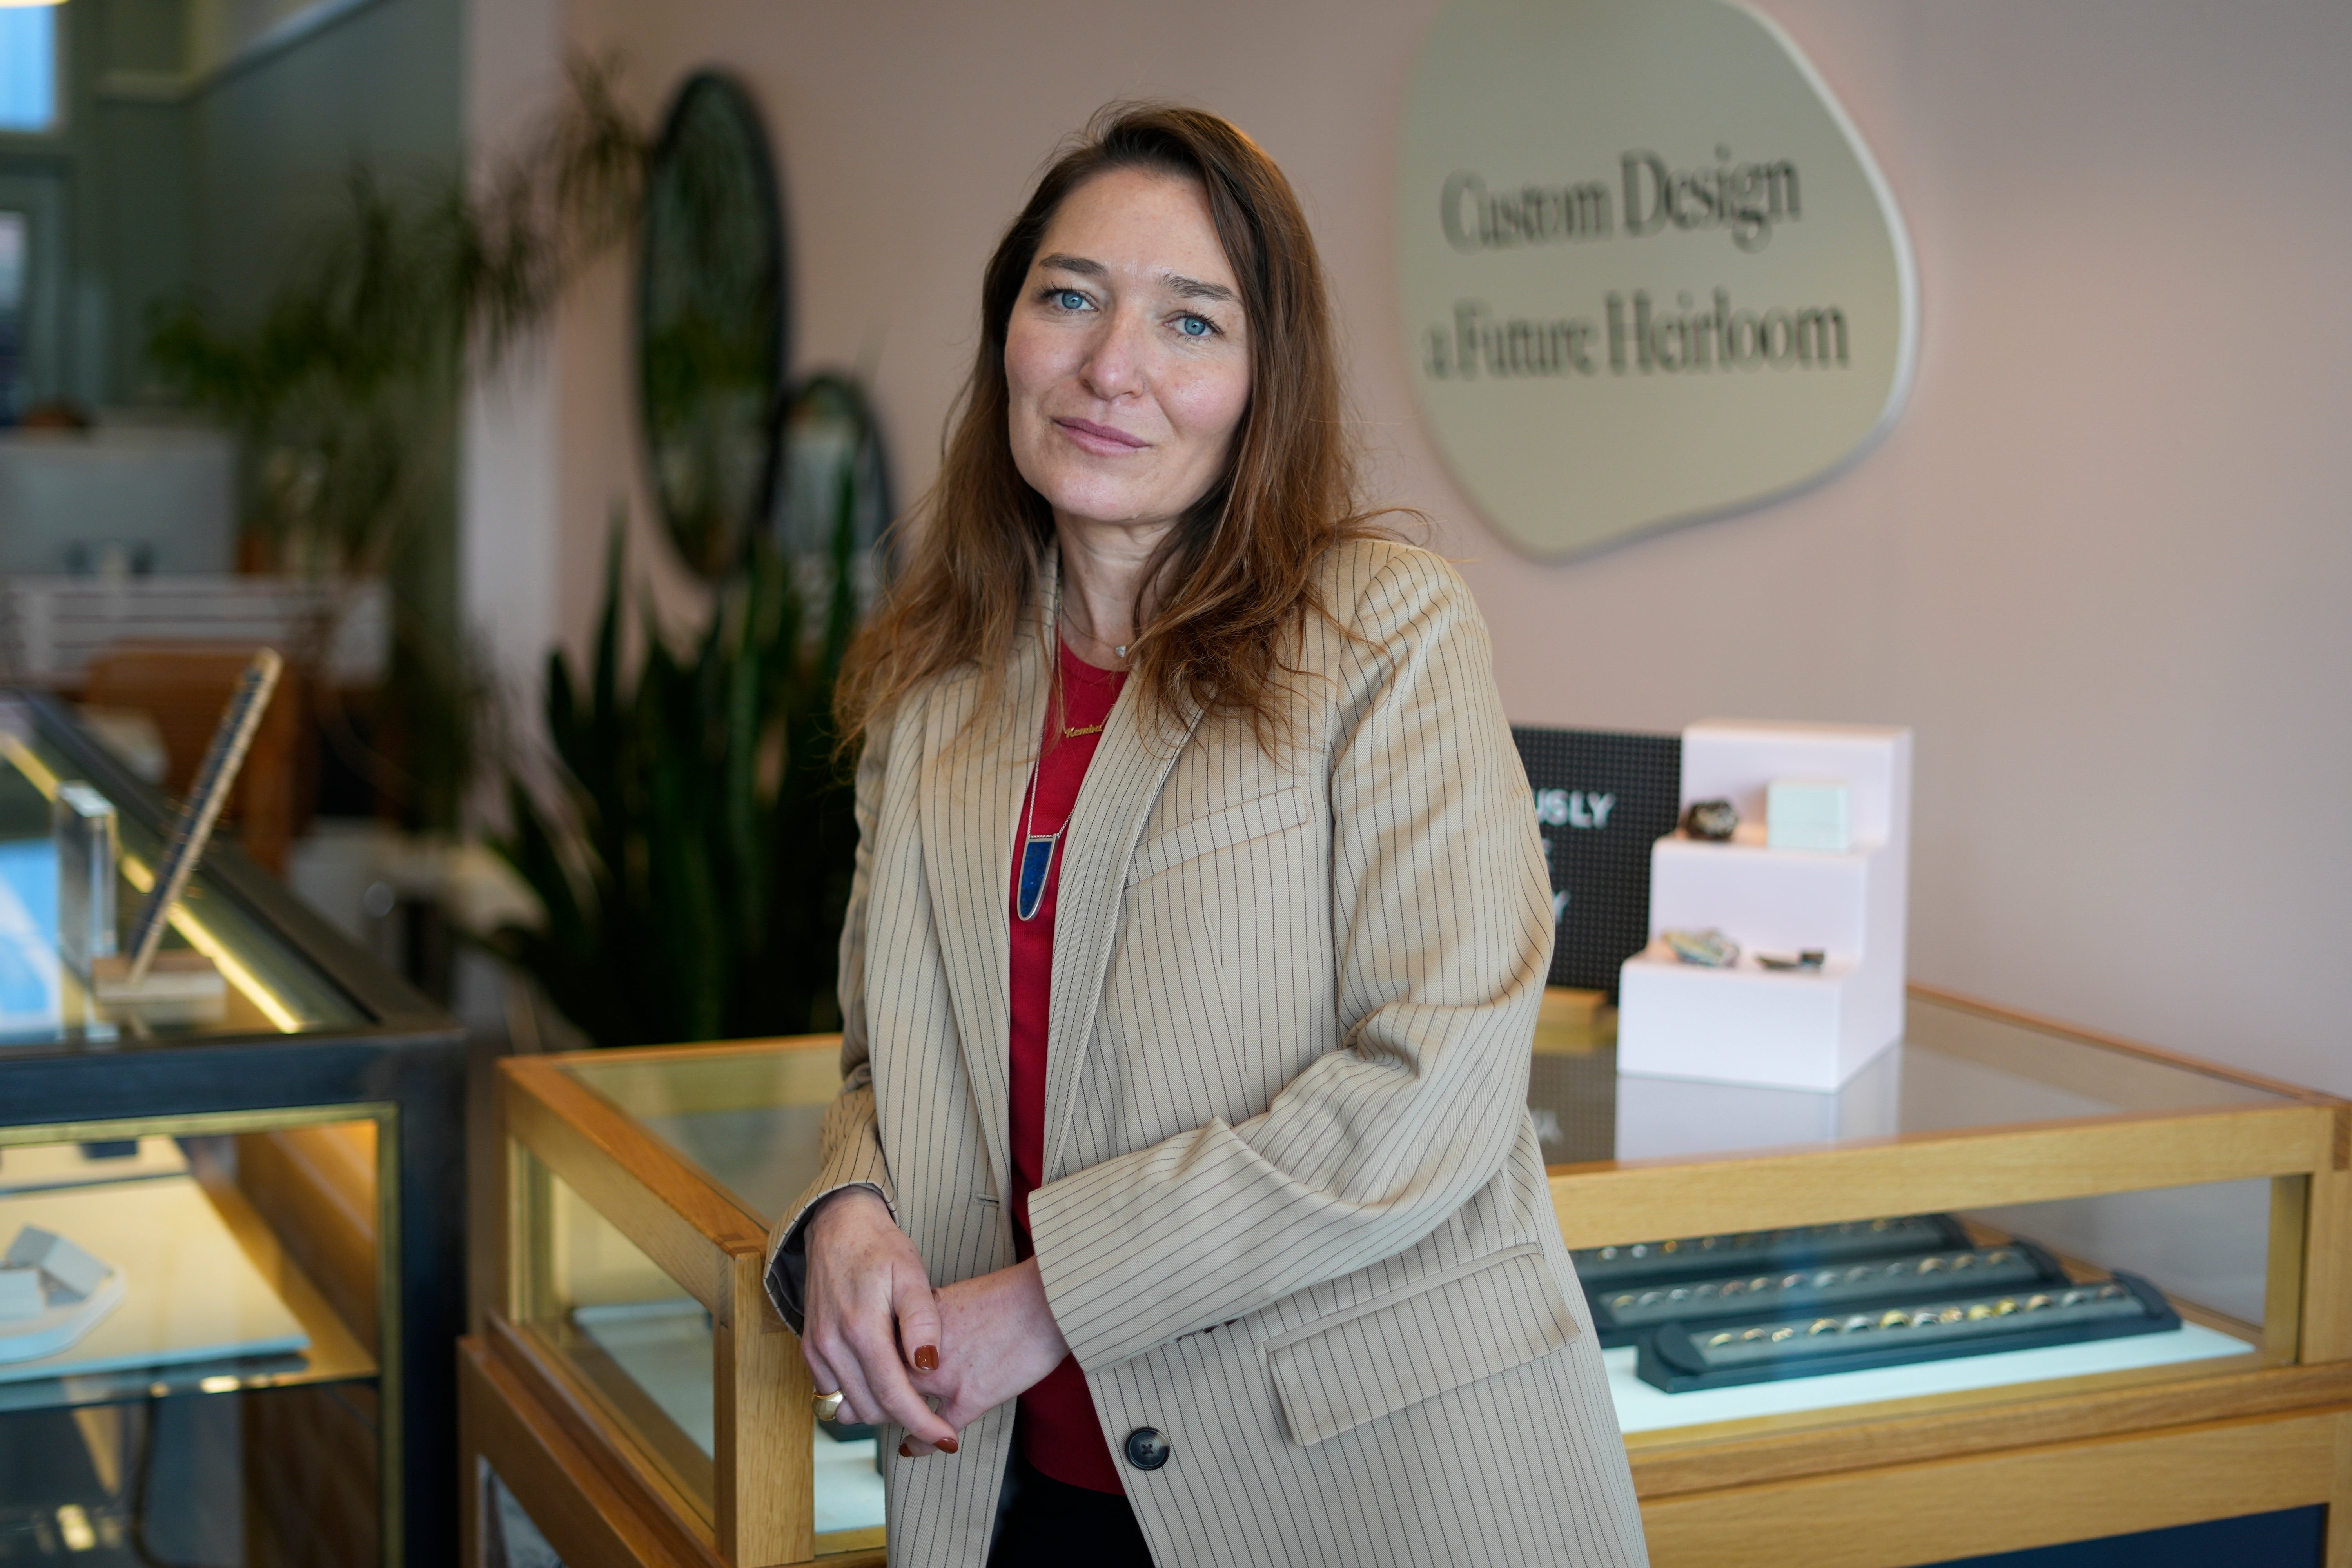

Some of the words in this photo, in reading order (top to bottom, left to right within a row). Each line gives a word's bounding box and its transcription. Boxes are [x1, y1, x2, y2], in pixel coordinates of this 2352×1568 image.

[1440, 168, 1613, 255] Custom
[1620, 143, 1802, 253] Design
[1421, 322, 1454, 380] a
[1454, 297, 1600, 380] Future
[1604, 285, 1851, 376] Heirloom
